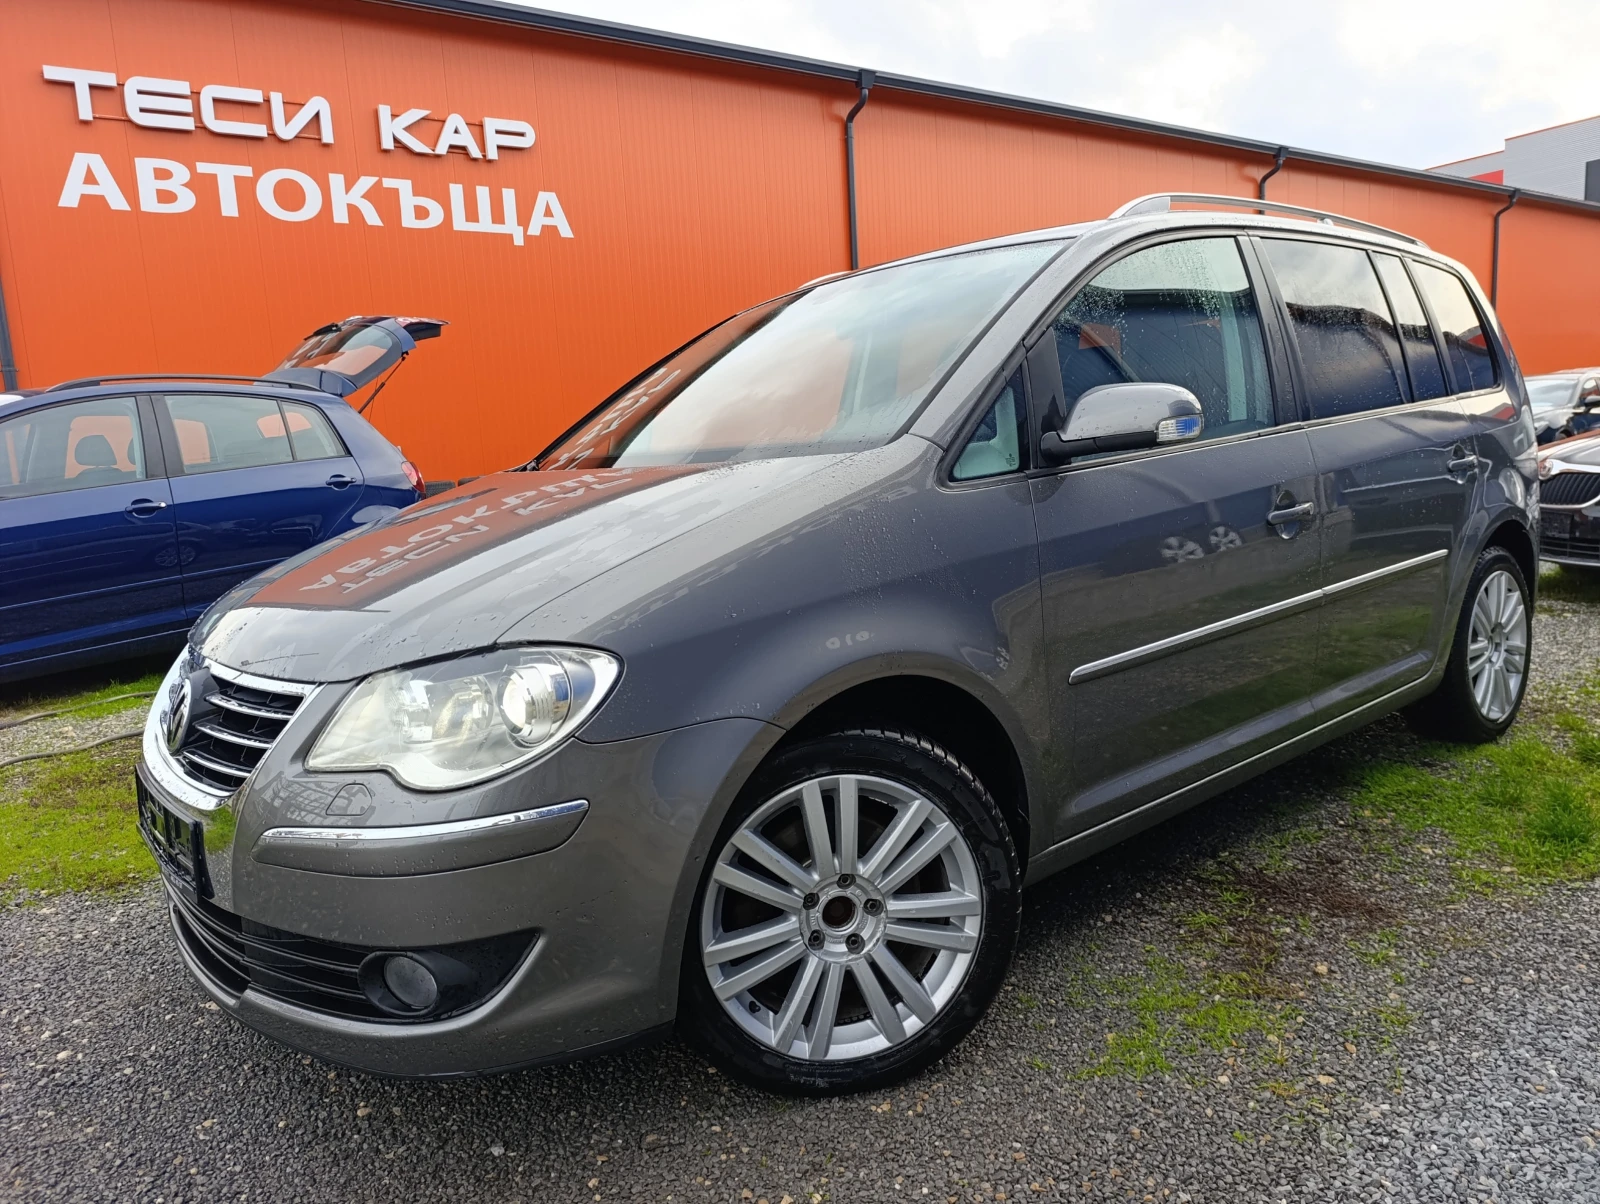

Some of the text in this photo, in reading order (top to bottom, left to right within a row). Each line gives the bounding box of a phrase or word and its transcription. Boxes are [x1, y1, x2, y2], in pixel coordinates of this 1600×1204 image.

[42, 64, 536, 161] ТЕСИ КАР
[57, 152, 575, 246] АВТОКЪЩА
